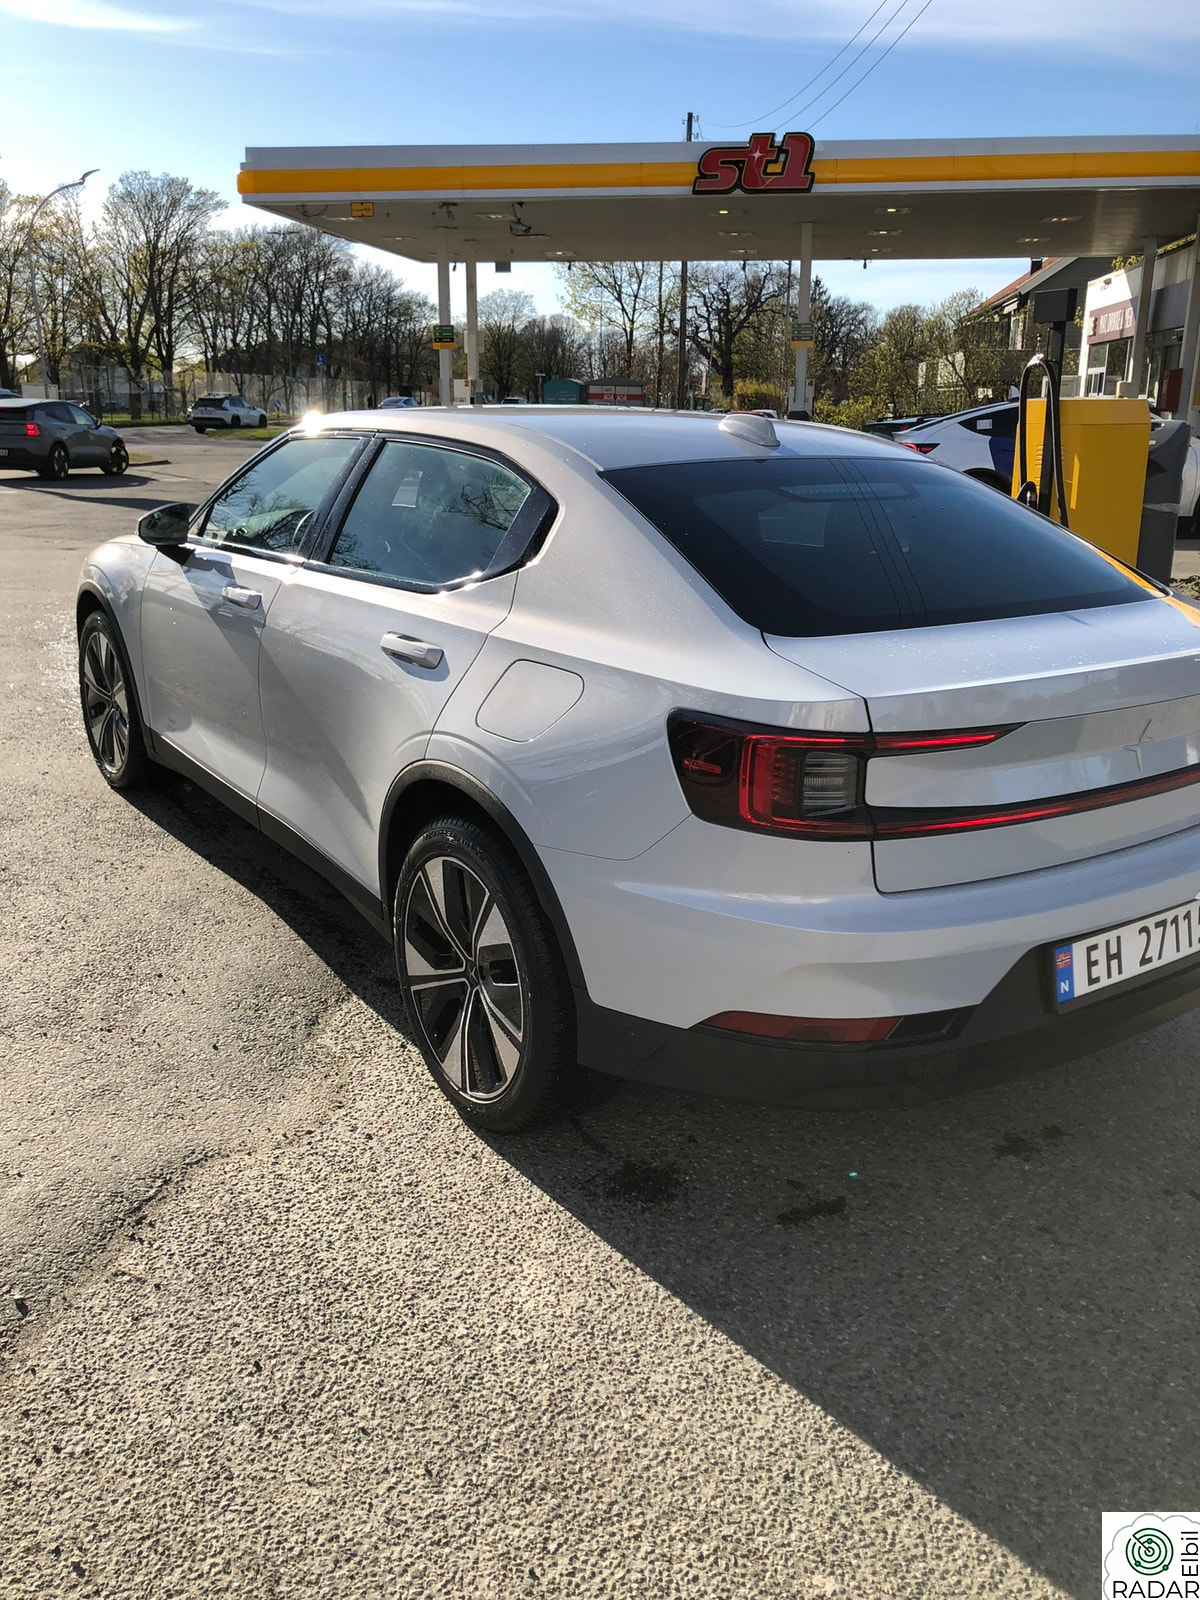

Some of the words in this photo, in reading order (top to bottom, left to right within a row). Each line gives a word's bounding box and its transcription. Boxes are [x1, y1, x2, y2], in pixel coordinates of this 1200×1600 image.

[693, 132, 815, 194] st1
[1086, 935, 1123, 987] EH
[1138, 906, 1200, 967] 2711
[1060, 980, 1069, 994] N
